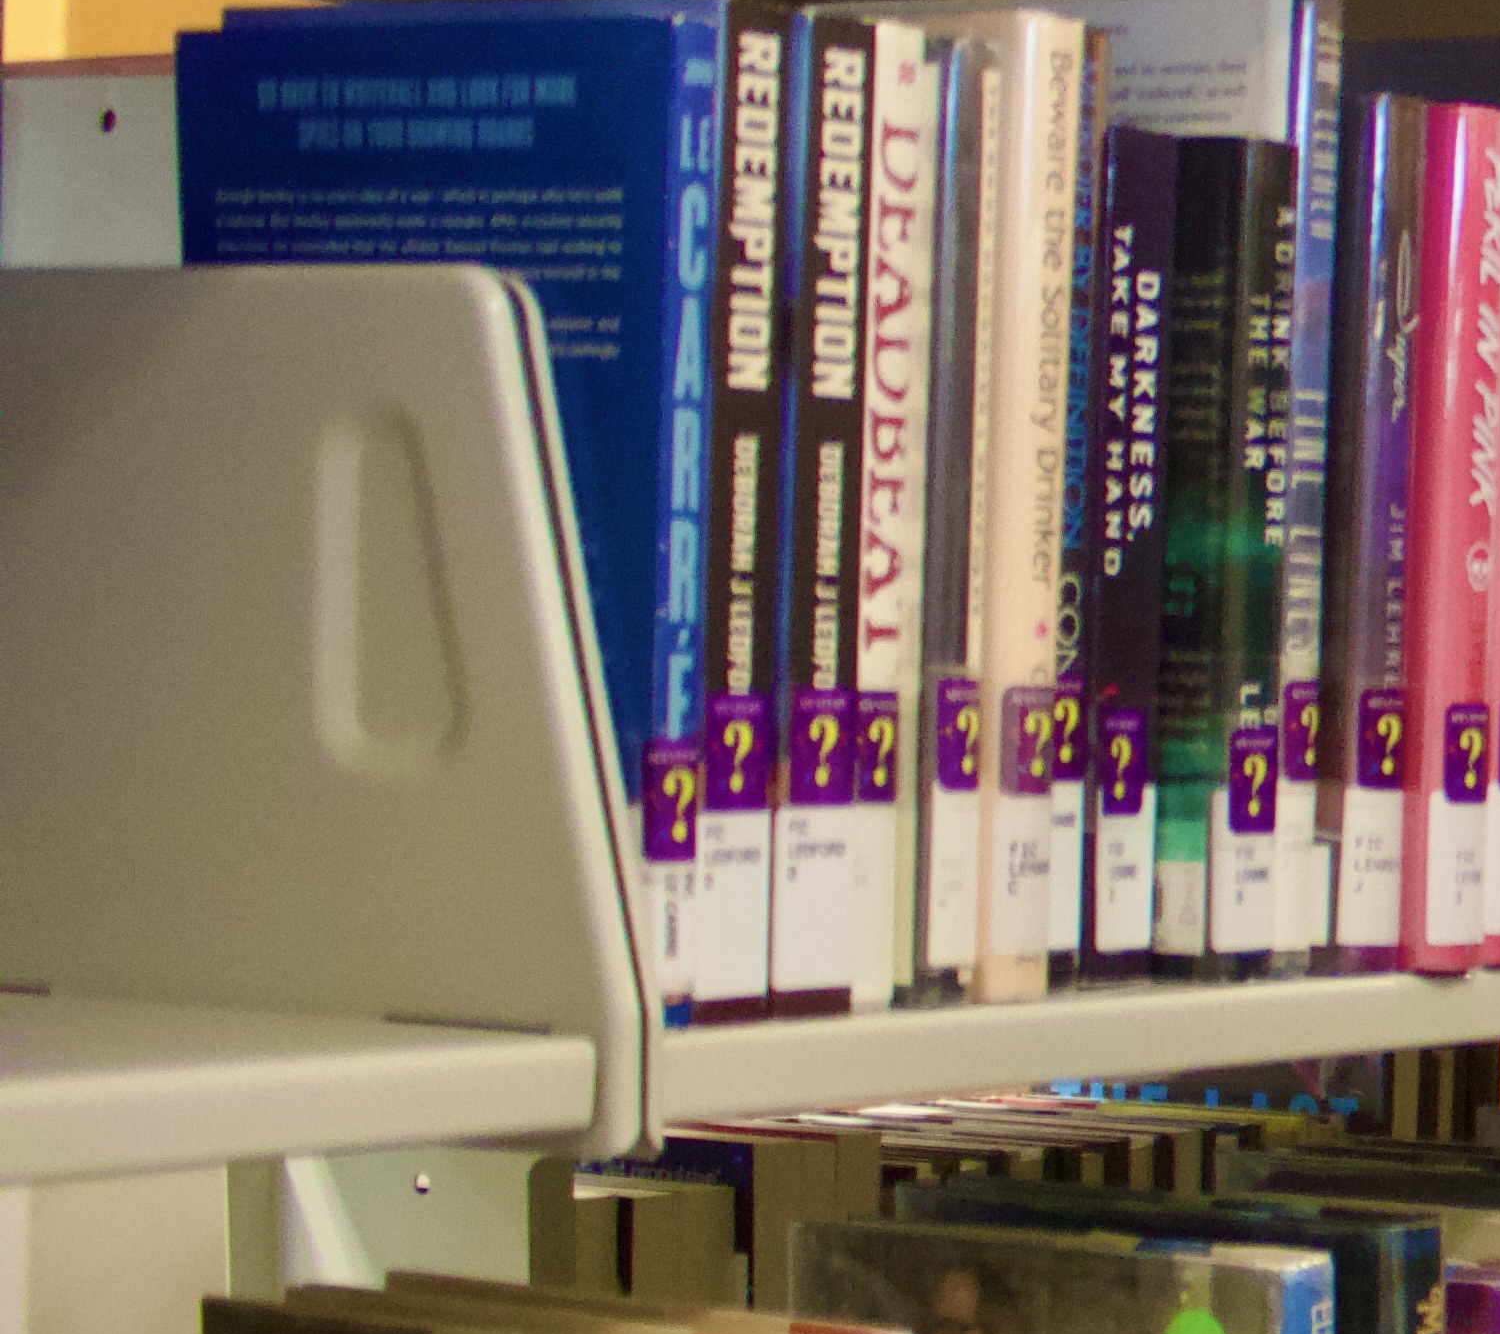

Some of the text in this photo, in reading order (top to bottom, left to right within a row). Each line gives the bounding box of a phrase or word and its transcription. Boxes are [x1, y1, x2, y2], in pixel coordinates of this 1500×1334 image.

[726, 29, 782, 392] REDEMPTION
[810, 47, 867, 400] REDEMPTION
[1030, 48, 1075, 584] Beware the Solitary Drinker
[1476, 301, 1500, 376] IN
[730, 434, 761, 573] DEBORAH
[814, 441, 845, 577] DEBORAH
[863, 123, 922, 651] DEADBEAT
[1103, 222, 1134, 577] TAKE MY HAND
[1127, 268, 1163, 543] DARKNESS,
[1243, 292, 1271, 470] THE WAR
[1262, 205, 1295, 547] A DRINK BEFORE
[1466, 378, 1498, 519] PINK
